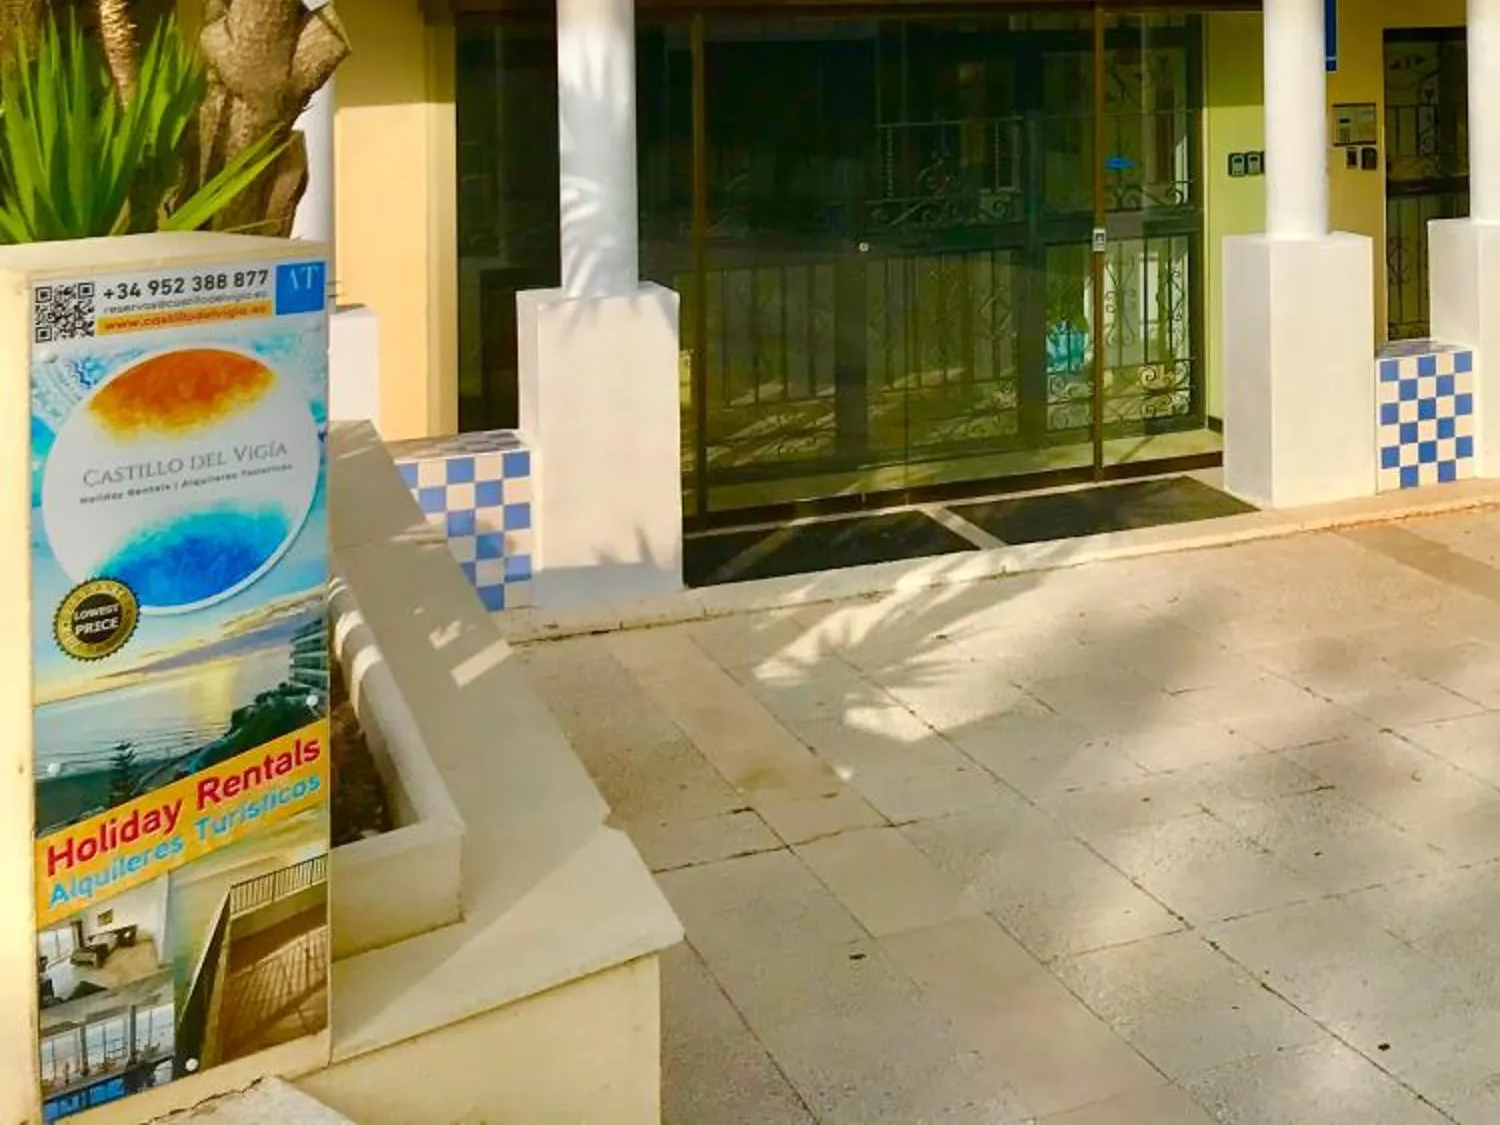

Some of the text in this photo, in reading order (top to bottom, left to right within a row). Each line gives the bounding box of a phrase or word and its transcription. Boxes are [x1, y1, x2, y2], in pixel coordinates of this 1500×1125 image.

[103, 269, 269, 300] +34 952 388 877
[74, 602, 121, 622] LOWEST
[75, 617, 119, 636] PRICE
[47, 738, 320, 877] Holiday Rentals
[50, 835, 184, 906] Alquileres
